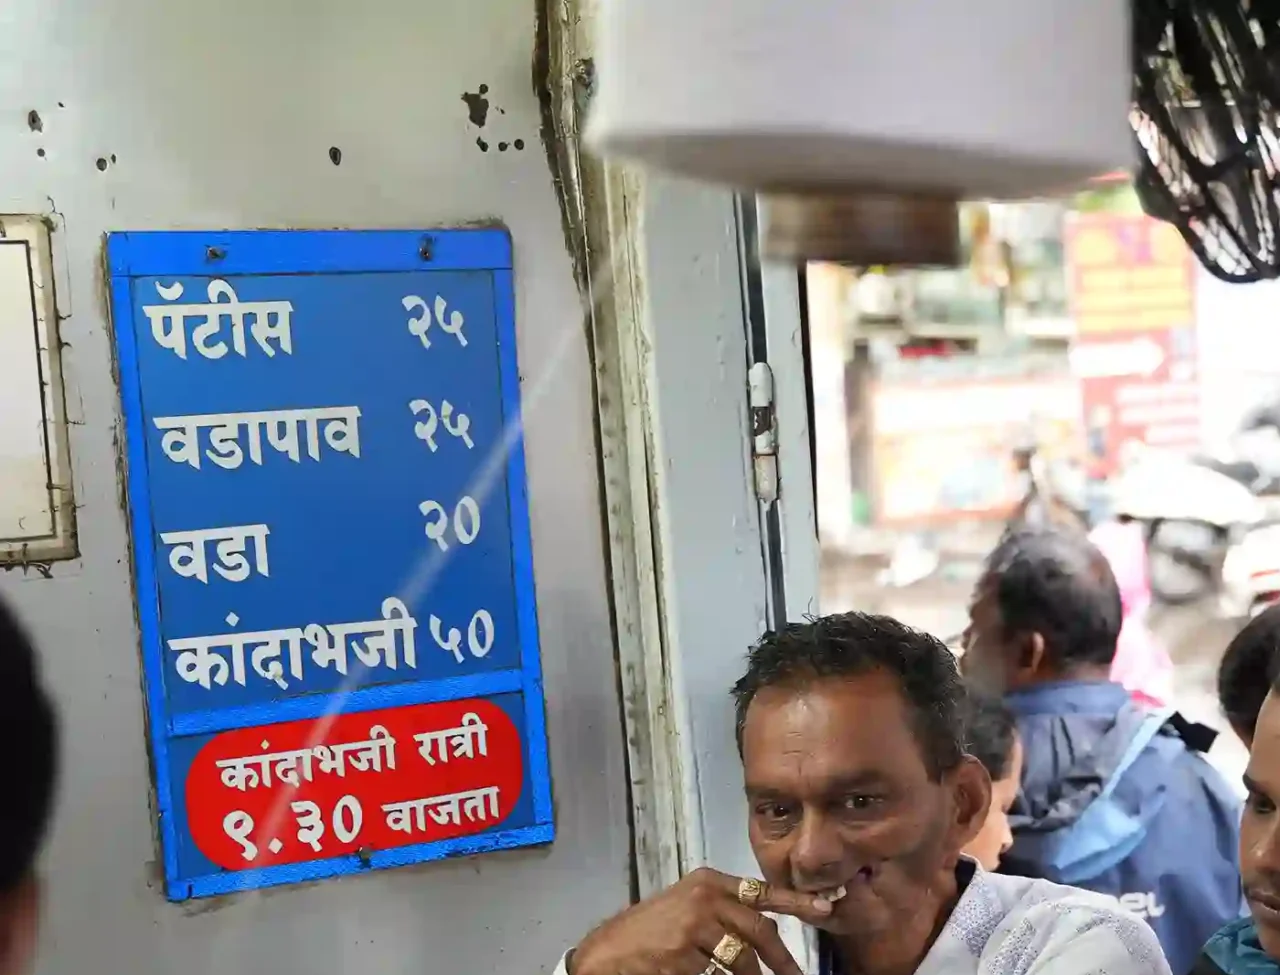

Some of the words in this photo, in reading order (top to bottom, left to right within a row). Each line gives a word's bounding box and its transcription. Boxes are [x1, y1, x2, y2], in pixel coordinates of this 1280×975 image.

[142, 278, 294, 360] पॅटीस
[401, 295, 468, 349] २५
[152, 405, 362, 470] वडापाव
[409, 399, 474, 453] २५
[159, 523, 270, 584] वडा
[419, 495, 481, 552] २०
[166, 596, 418, 690] कांदाभजी
[429, 609, 495, 663] ५०
[215, 724, 396, 792] कांदाभजी
[413, 712, 488, 766] रात्री
[222, 794, 363, 861] ९.३०
[381, 786, 500, 834] वाजता
